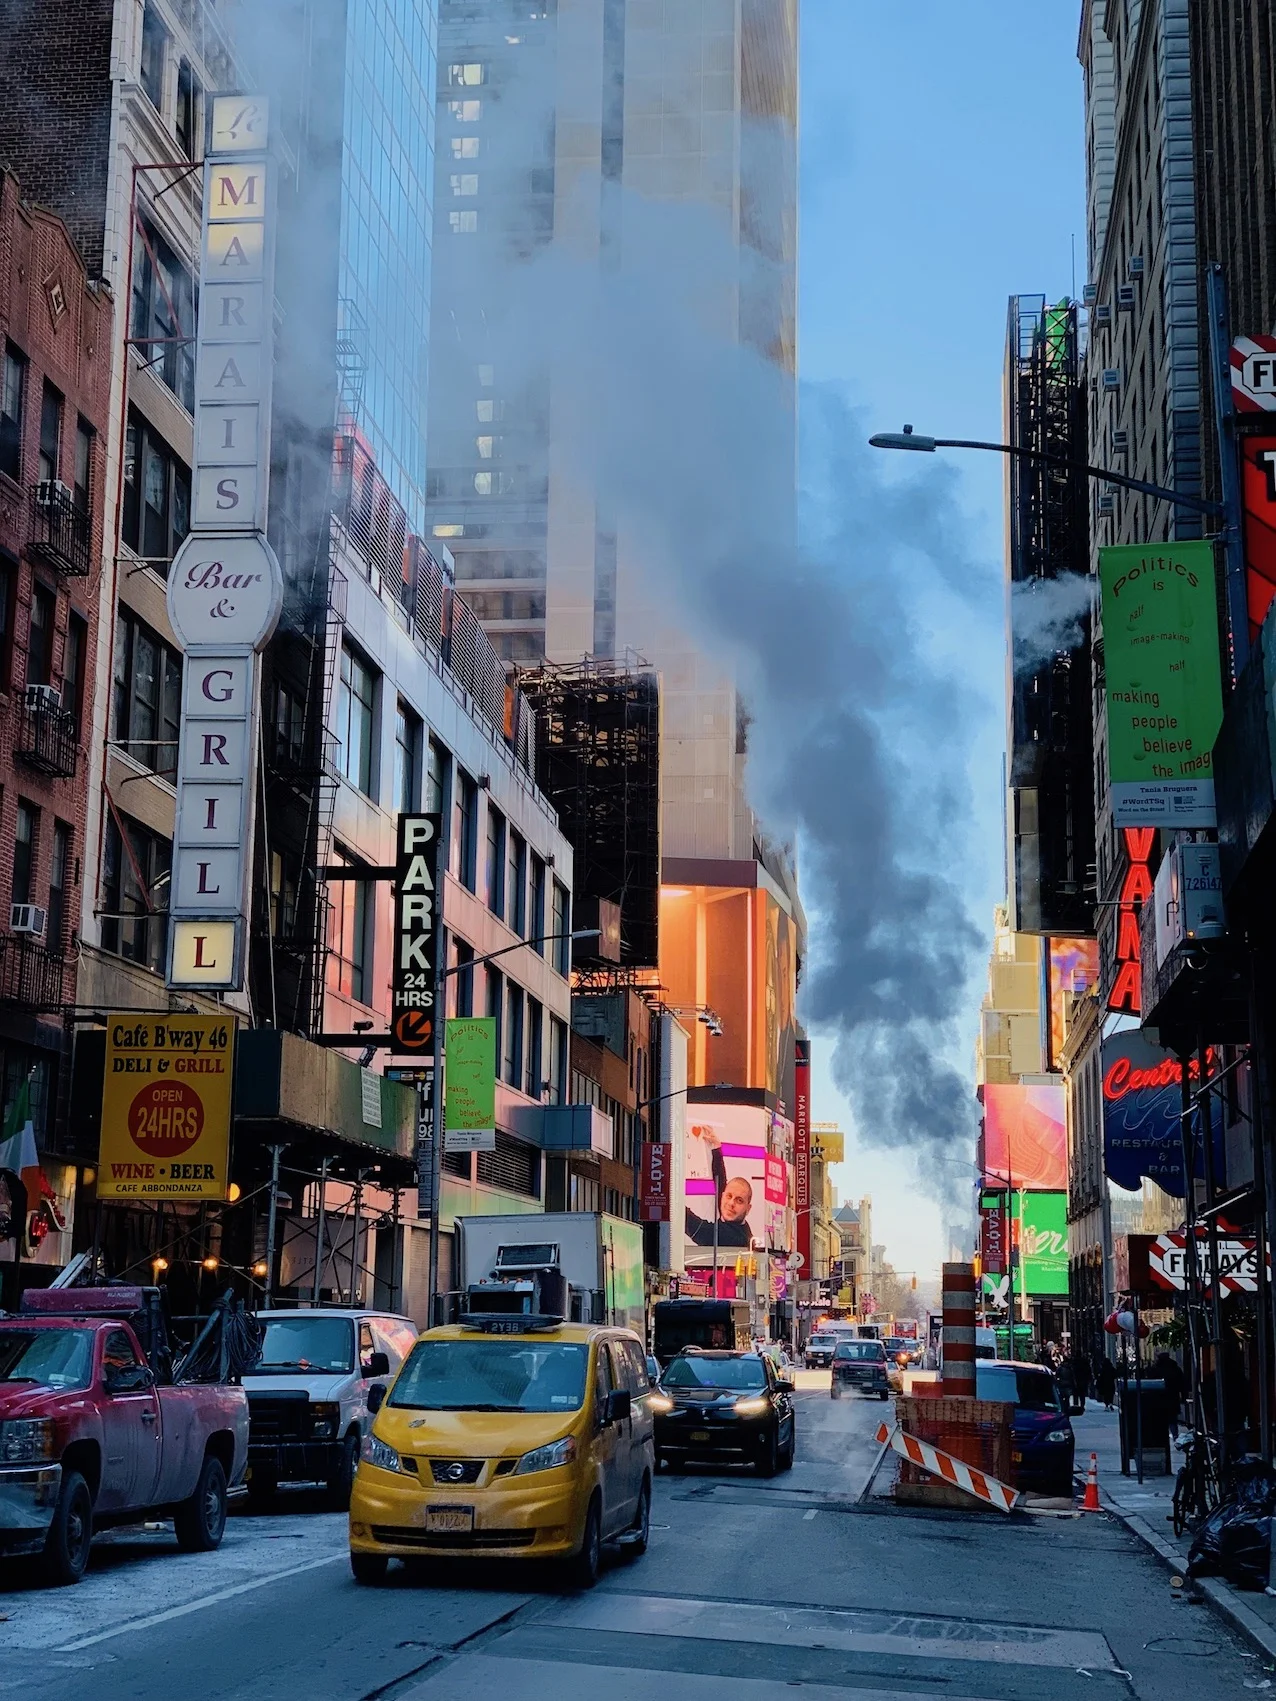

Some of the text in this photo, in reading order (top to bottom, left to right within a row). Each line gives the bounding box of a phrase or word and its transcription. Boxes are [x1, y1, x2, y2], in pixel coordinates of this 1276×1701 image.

[214, 175, 259, 510] MARAIS
[185, 560, 262, 590] Bar
[1153, 579, 1164, 591] is
[210, 598, 237, 619] &
[1130, 632, 1190, 646] image-making
[1169, 660, 1185, 672] half
[1112, 690, 1160, 708] making
[1132, 714, 1178, 732] people
[1143, 737, 1193, 754] believe
[1152, 750, 1211, 777] the imag
[193, 669, 235, 969] GRILL
[1201, 865, 1210, 877] C
[1186, 877, 1222, 891] 726147
[401, 819, 435, 969] PARK
[404, 973, 427, 988] 24
[395, 990, 434, 1007] HRS
[112, 1024, 228, 1055] Café B'way 46
[112, 1058, 225, 1073] DELI & GRILL
[152, 1089, 183, 1102] OPEN
[136, 1106, 198, 1139] 24HRS
[798, 1095, 806, 1151] MARRIOTT
[111, 1163, 215, 1180] WINE BEER
[650, 1144, 664, 1193] LOVE
[1148, 1164, 1181, 1175] BAR
[116, 1183, 203, 1193] CAFE ABBONDANZA
[798, 1154, 806, 1204] MARQUIS
[988, 1208, 1000, 1250] LOVE
